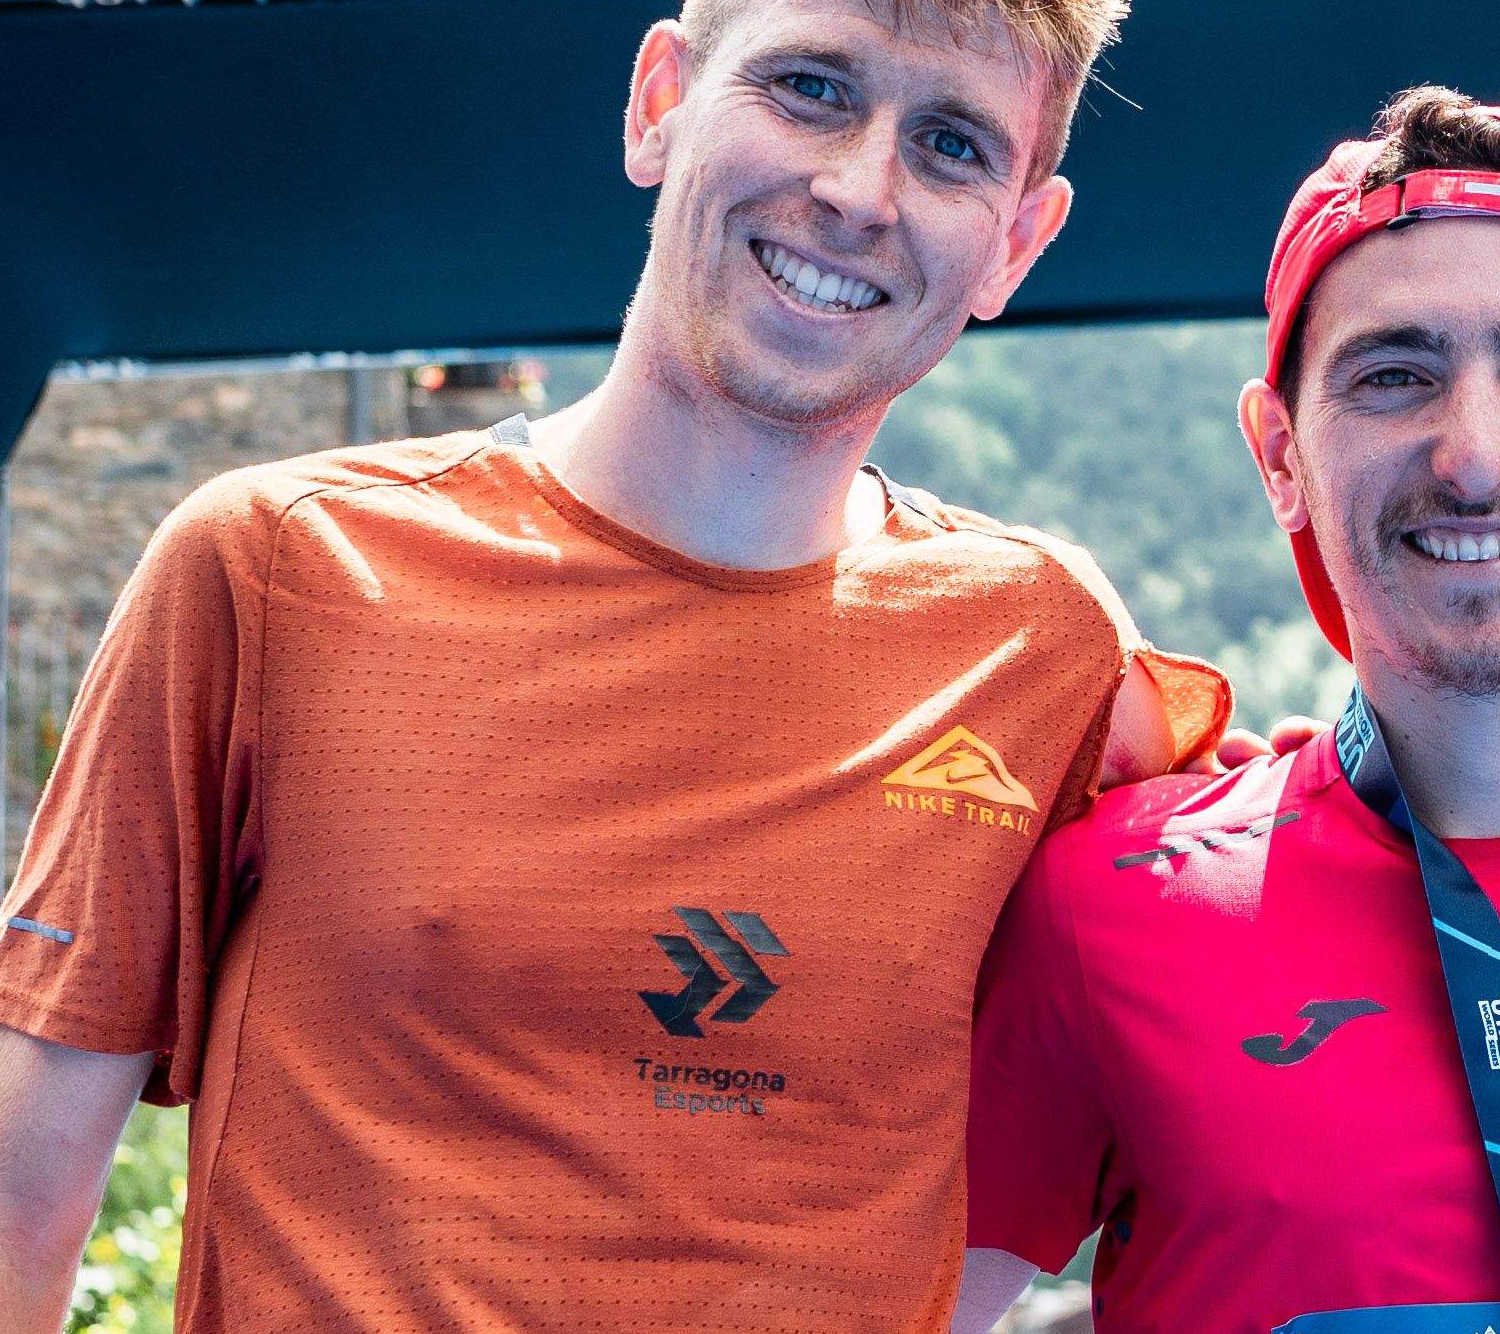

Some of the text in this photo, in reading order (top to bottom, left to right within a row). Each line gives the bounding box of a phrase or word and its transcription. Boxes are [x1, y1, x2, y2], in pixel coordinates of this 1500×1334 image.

[884, 789, 1031, 838] NIKE TRAIL
[1481, 1003, 1500, 1067] WORLD SERIES
[633, 1057, 786, 1094] Tarragona
[654, 1087, 766, 1116] Esports
